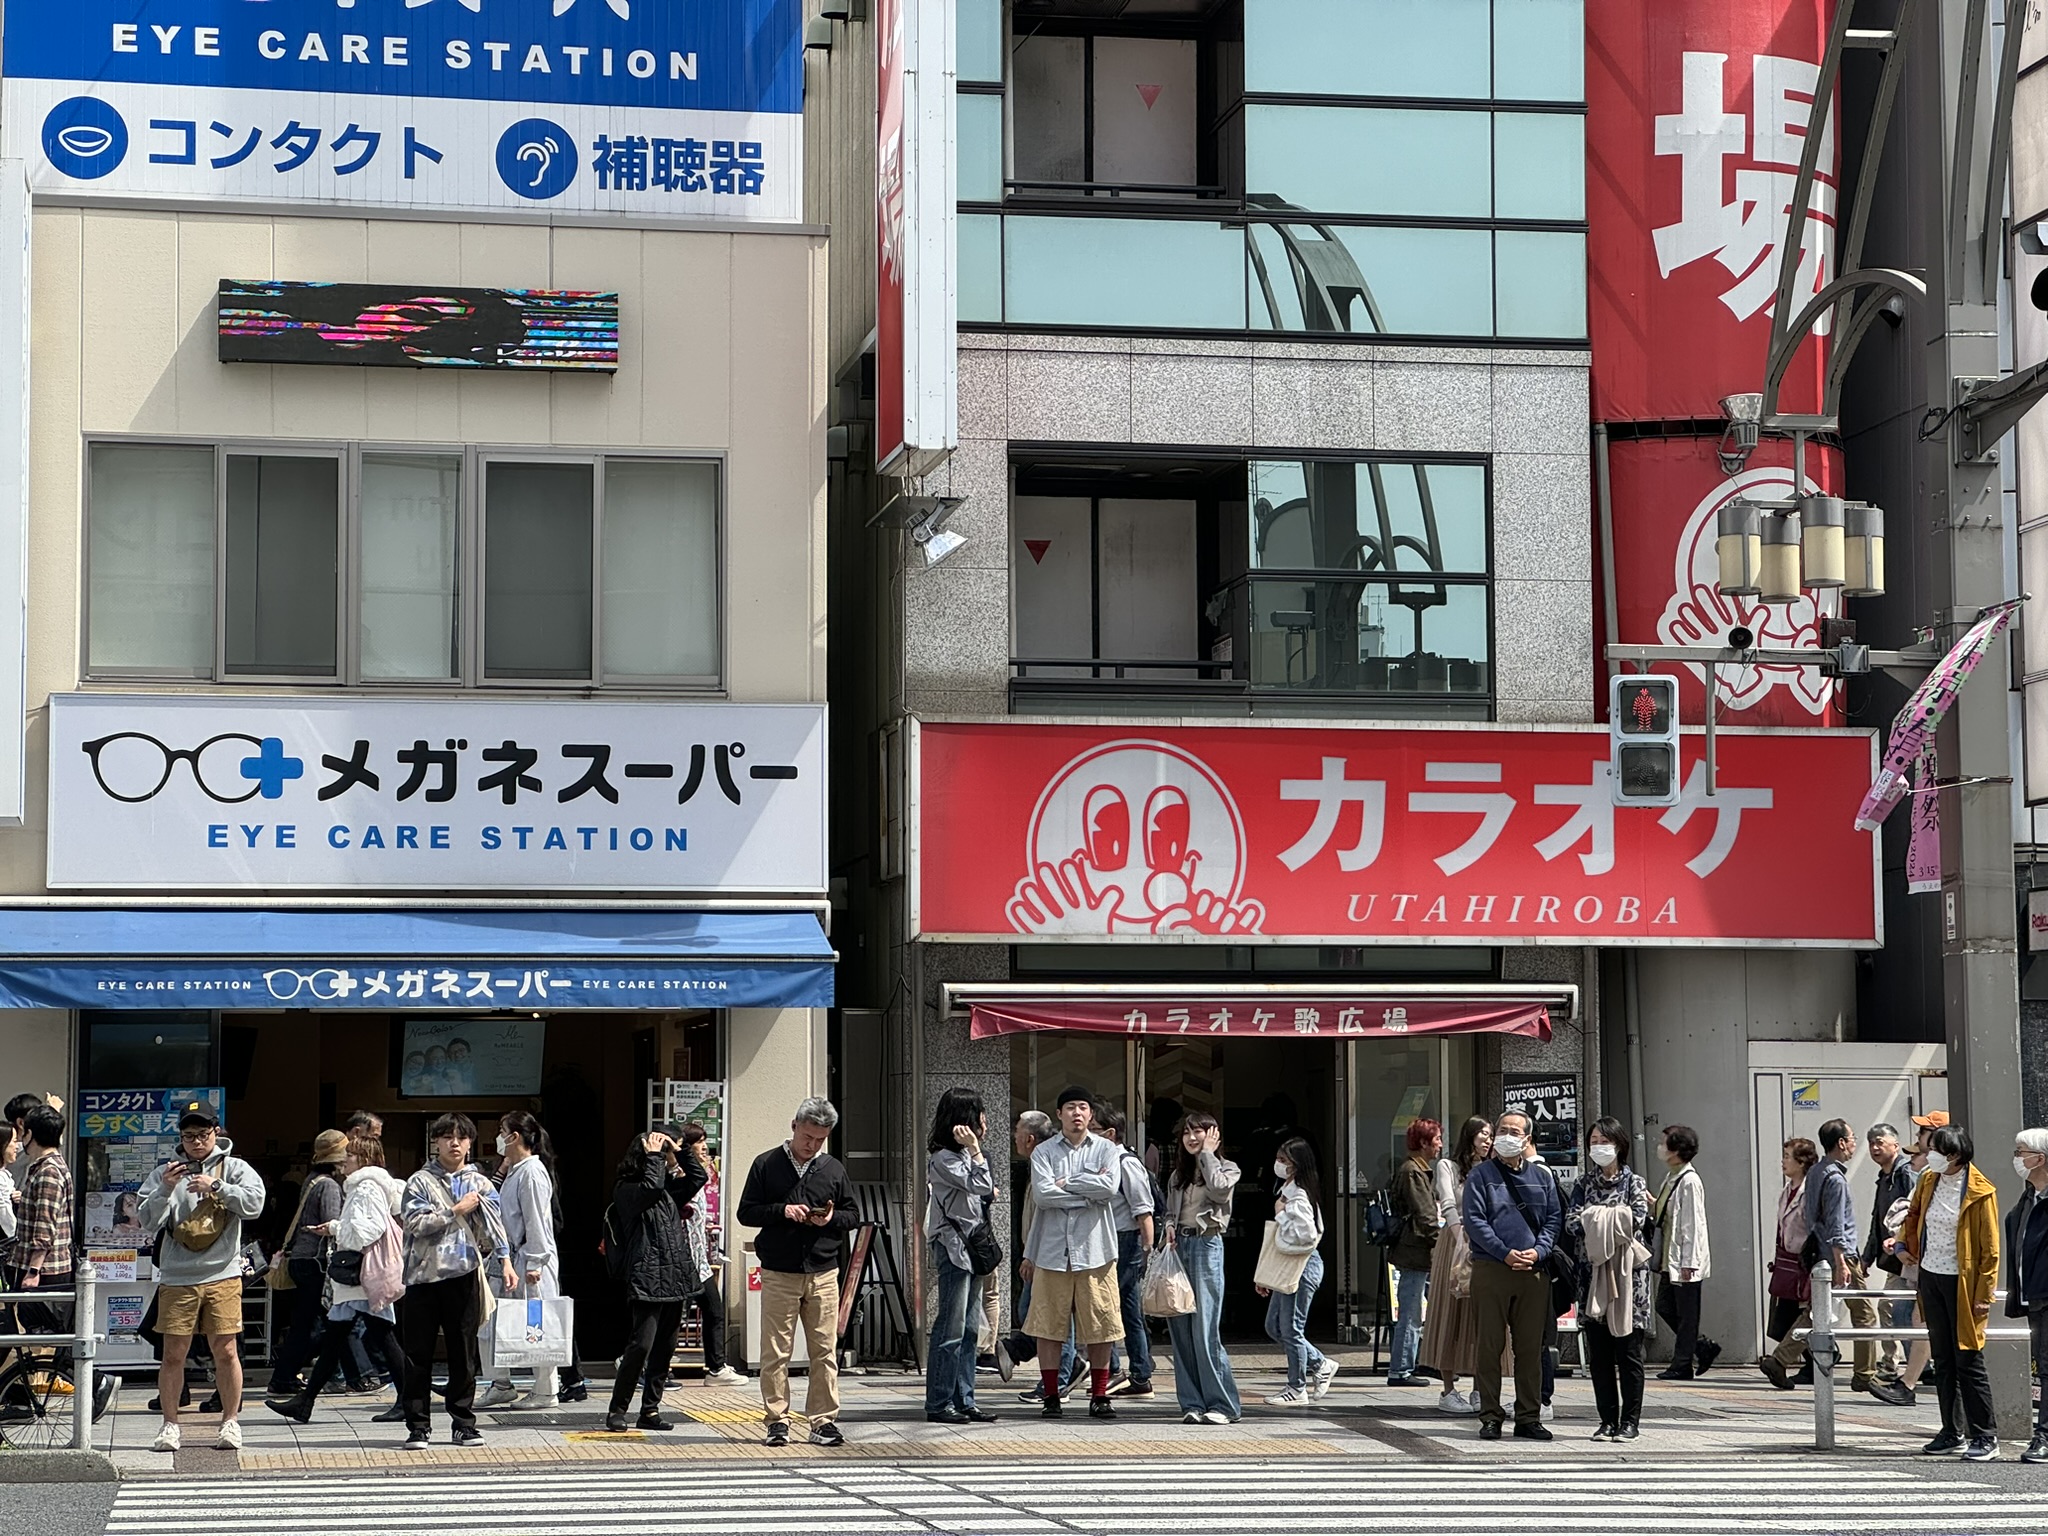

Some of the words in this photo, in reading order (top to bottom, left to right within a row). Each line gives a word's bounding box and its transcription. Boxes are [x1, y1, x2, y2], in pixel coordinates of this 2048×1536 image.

[112, 23, 220, 56] EYE
[258, 30, 409, 66] CARE
[445, 40, 698, 81] STATION
[148, 119, 444, 180] コンタクト
[592, 133, 766, 196] 補聴器
[317, 737, 799, 806] メガネスーパー
[1277, 756, 1774, 879] カラオケ
[207, 824, 297, 849] EYE
[327, 824, 452, 850] CARE
[480, 825, 690, 853] STATION
[1346, 894, 1681, 925] UTAHIROBA
[97, 981, 143, 990] EYE
[145, 981, 176, 990] CARE
[184, 981, 252, 991] STATION
[362, 969, 572, 999] メガネスーパー
[583, 980, 612, 989] EYE
[618, 980, 660, 989] CARE
[665, 980, 729, 990] STATION
[1123, 1006, 1410, 1036] カラオケ歌広場
[85, 1092, 156, 1111] コンタクト
[1504, 1086, 1560, 1102] JOYSOUND
[1562, 1084, 1576, 1095] X1
[116, 1254, 134, 1262] SALE
